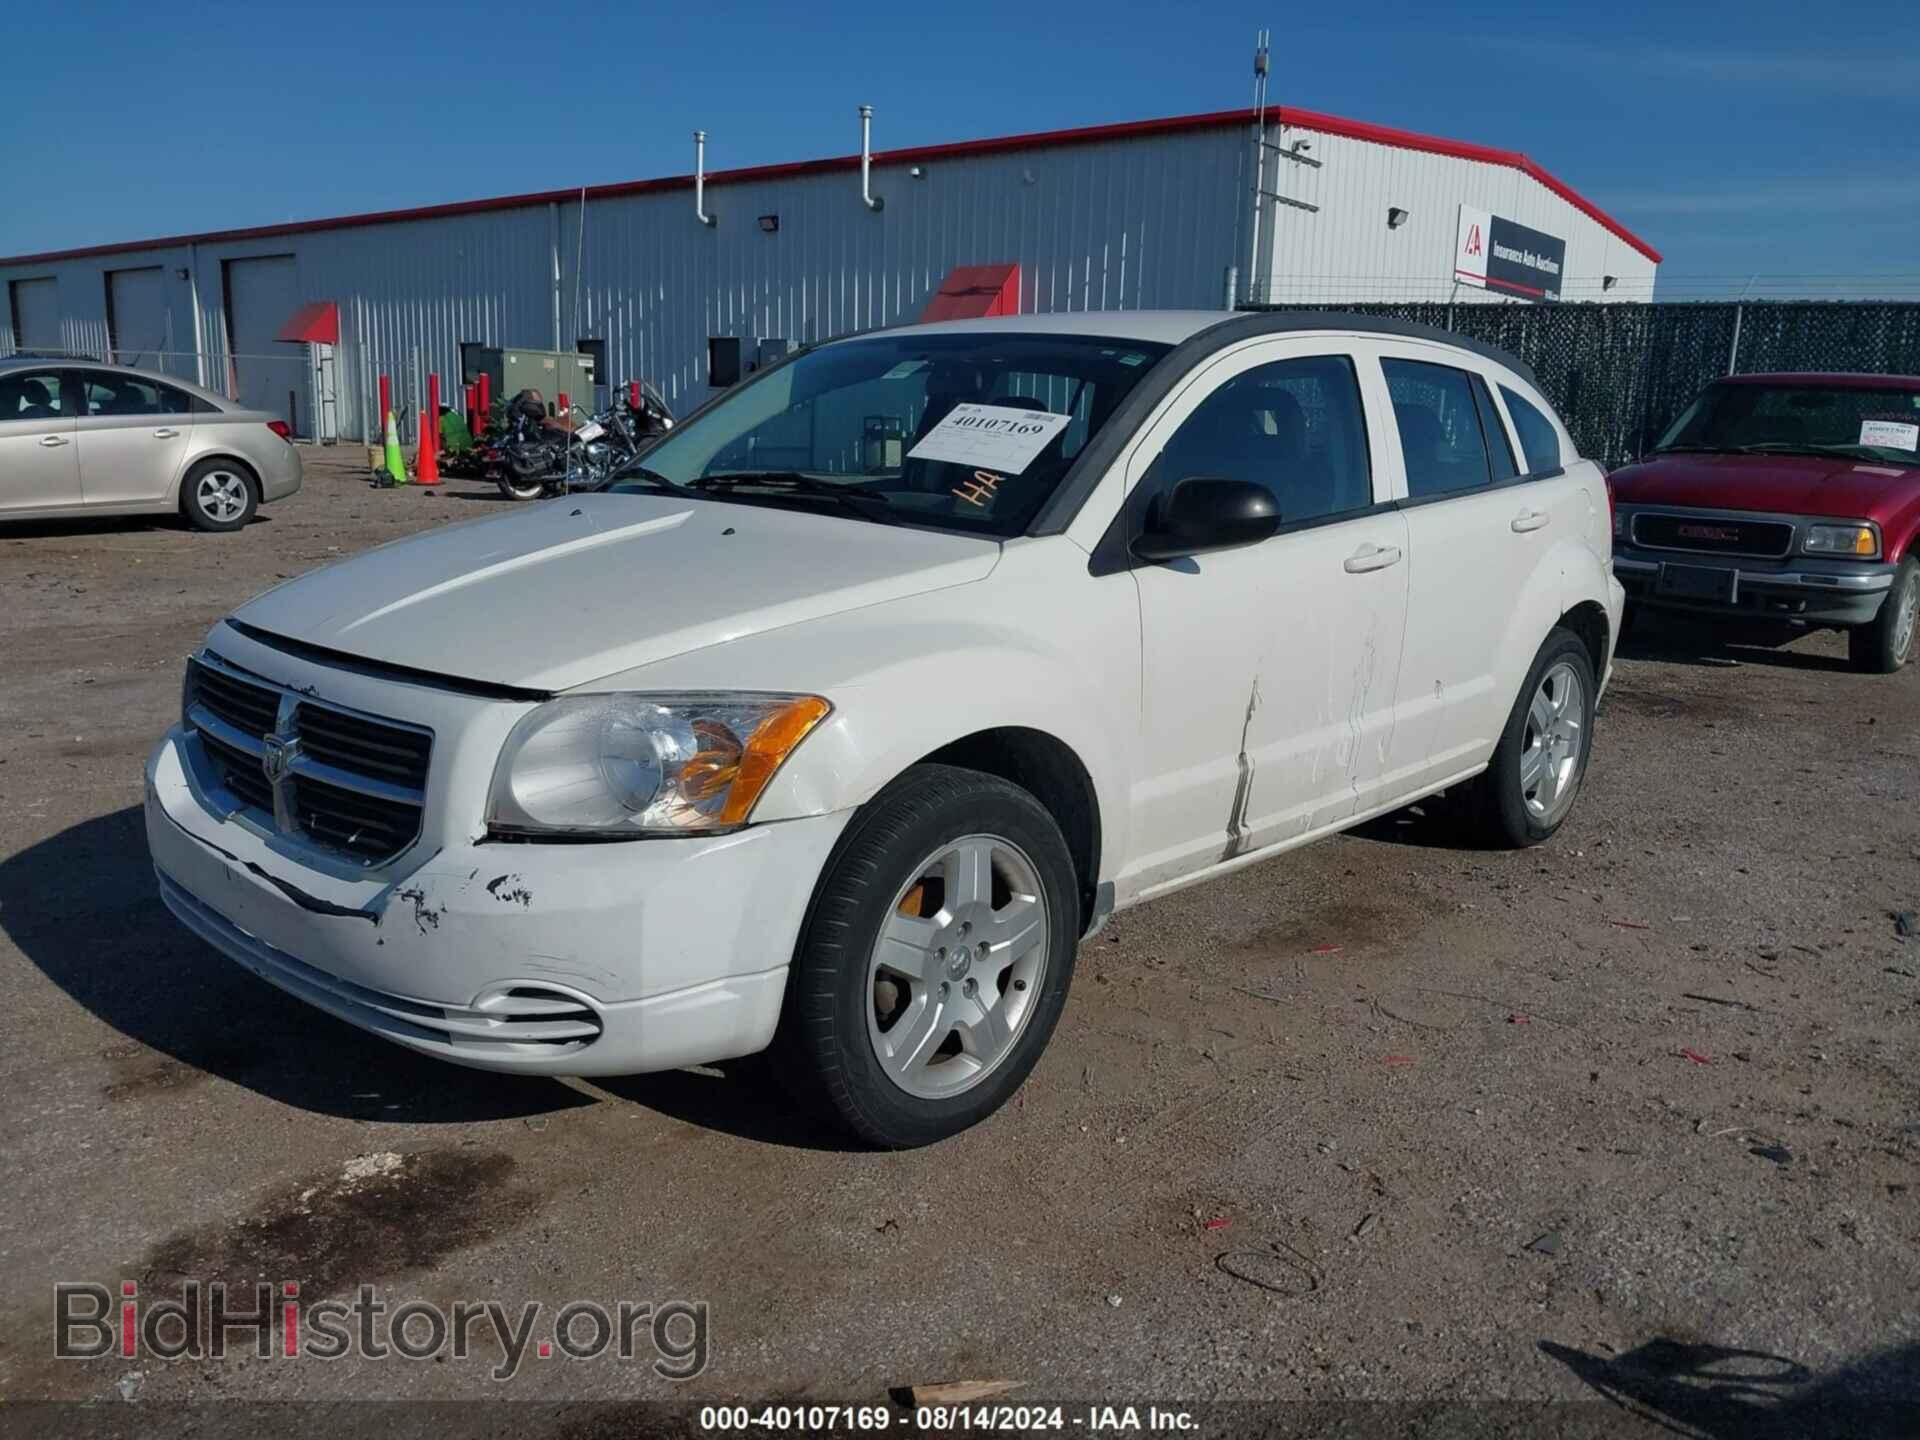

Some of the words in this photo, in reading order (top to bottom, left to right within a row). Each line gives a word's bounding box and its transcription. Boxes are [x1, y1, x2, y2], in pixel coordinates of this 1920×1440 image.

[1493, 240, 1523, 264] Insurance
[1523, 249, 1536, 268] Auto
[952, 416, 1044, 434] 40107169
